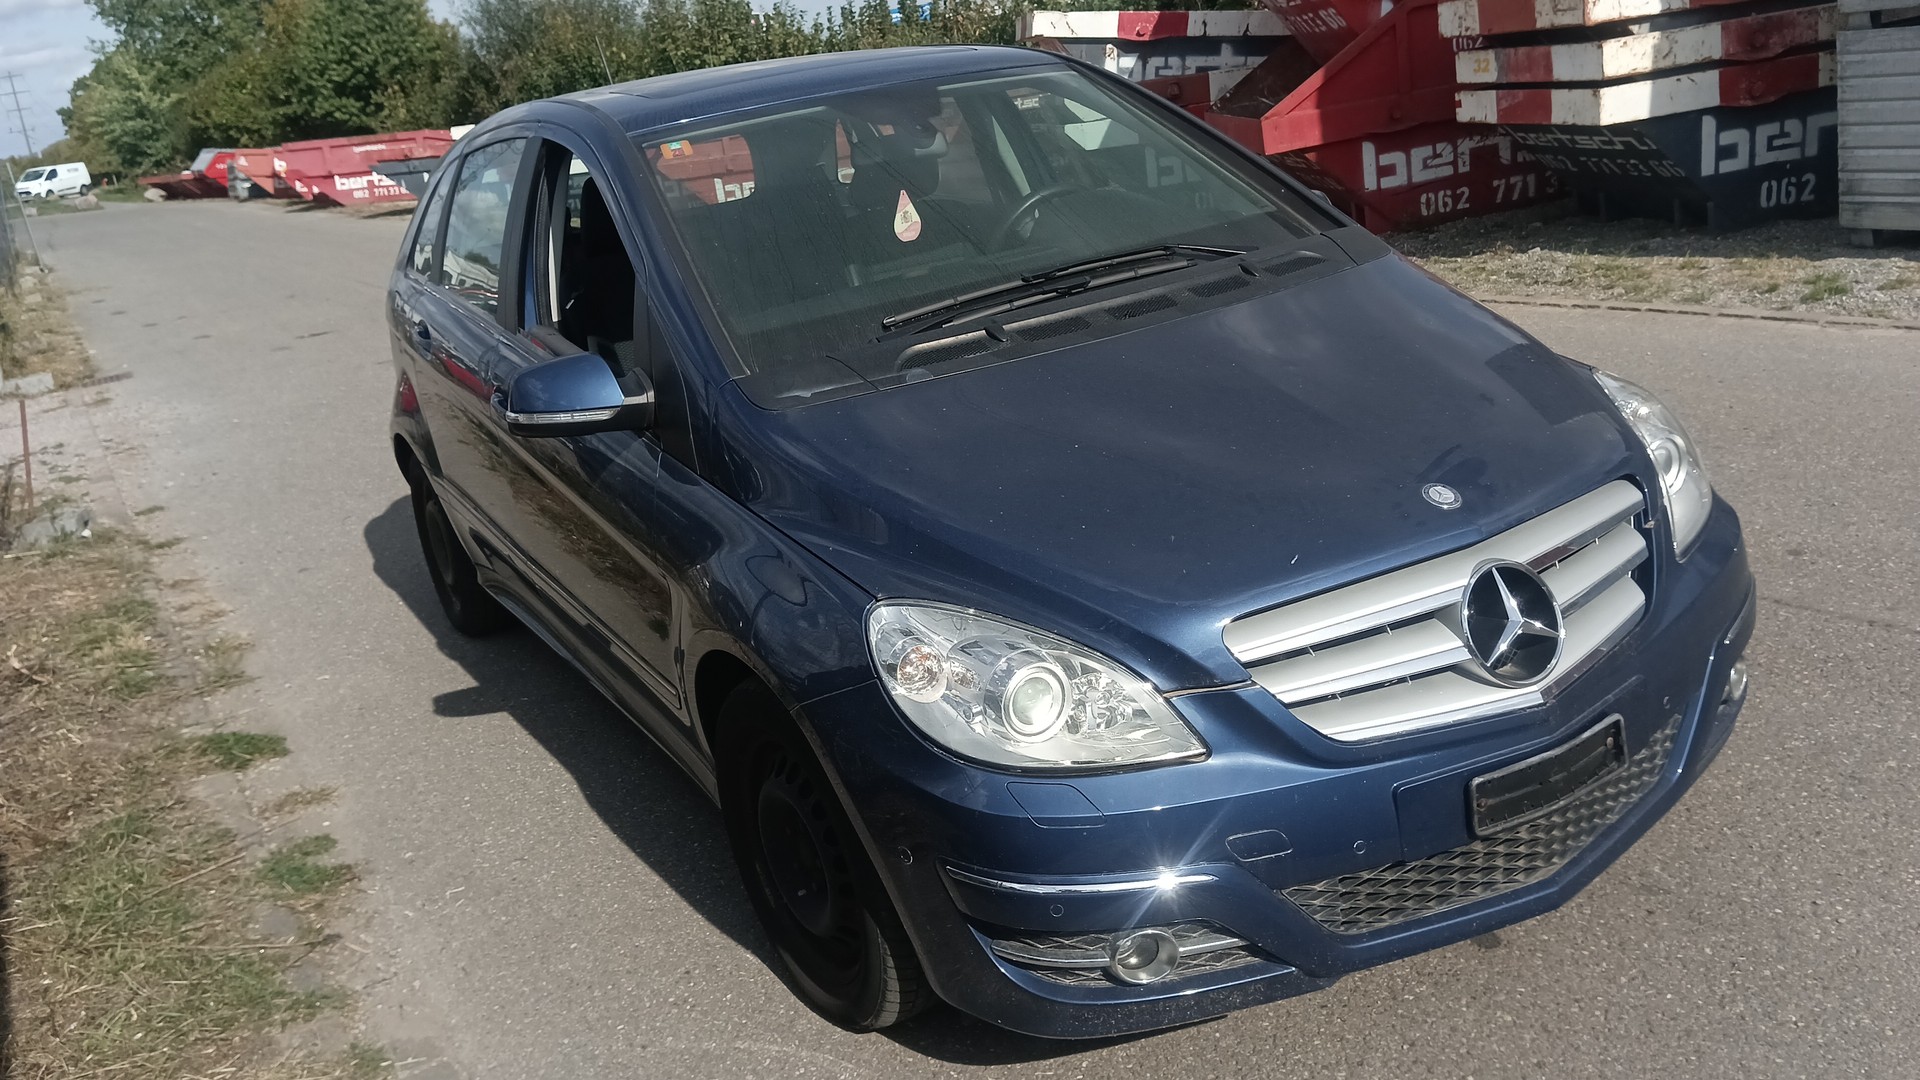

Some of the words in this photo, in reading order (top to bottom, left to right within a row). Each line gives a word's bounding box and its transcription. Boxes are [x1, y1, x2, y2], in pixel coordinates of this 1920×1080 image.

[1420, 186, 1470, 216] 062
[1493, 173, 1536, 203] 771
[1760, 172, 1816, 208] 062
